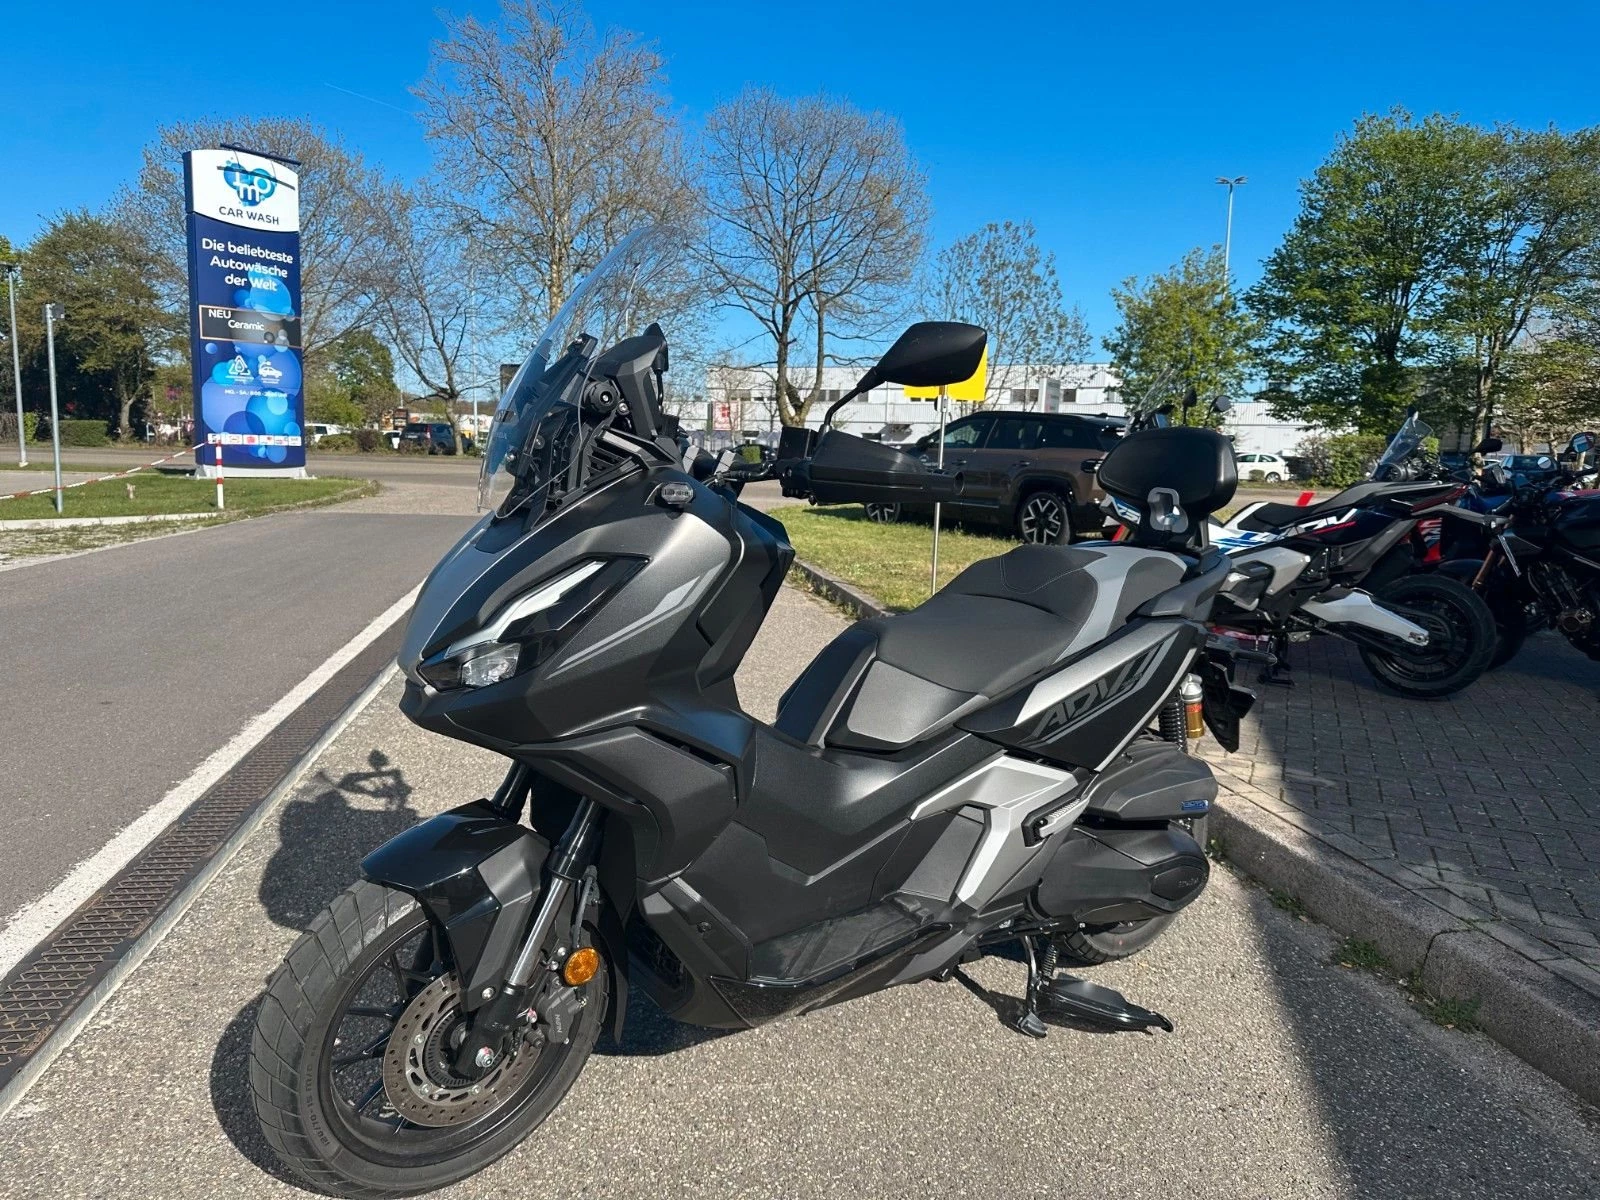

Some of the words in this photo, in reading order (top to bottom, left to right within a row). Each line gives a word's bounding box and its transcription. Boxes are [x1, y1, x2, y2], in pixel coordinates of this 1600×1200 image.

[218, 206, 244, 219] CAR
[246, 211, 280, 225] WASH
[202, 238, 225, 252] Die
[228, 241, 294, 264] beliebteste
[210, 256, 288, 279] Autowäsche
[225, 273, 247, 287] der
[249, 276, 278, 292] Welt
[208, 308, 232, 319] NEU
[228, 319, 265, 331] Ceramic
